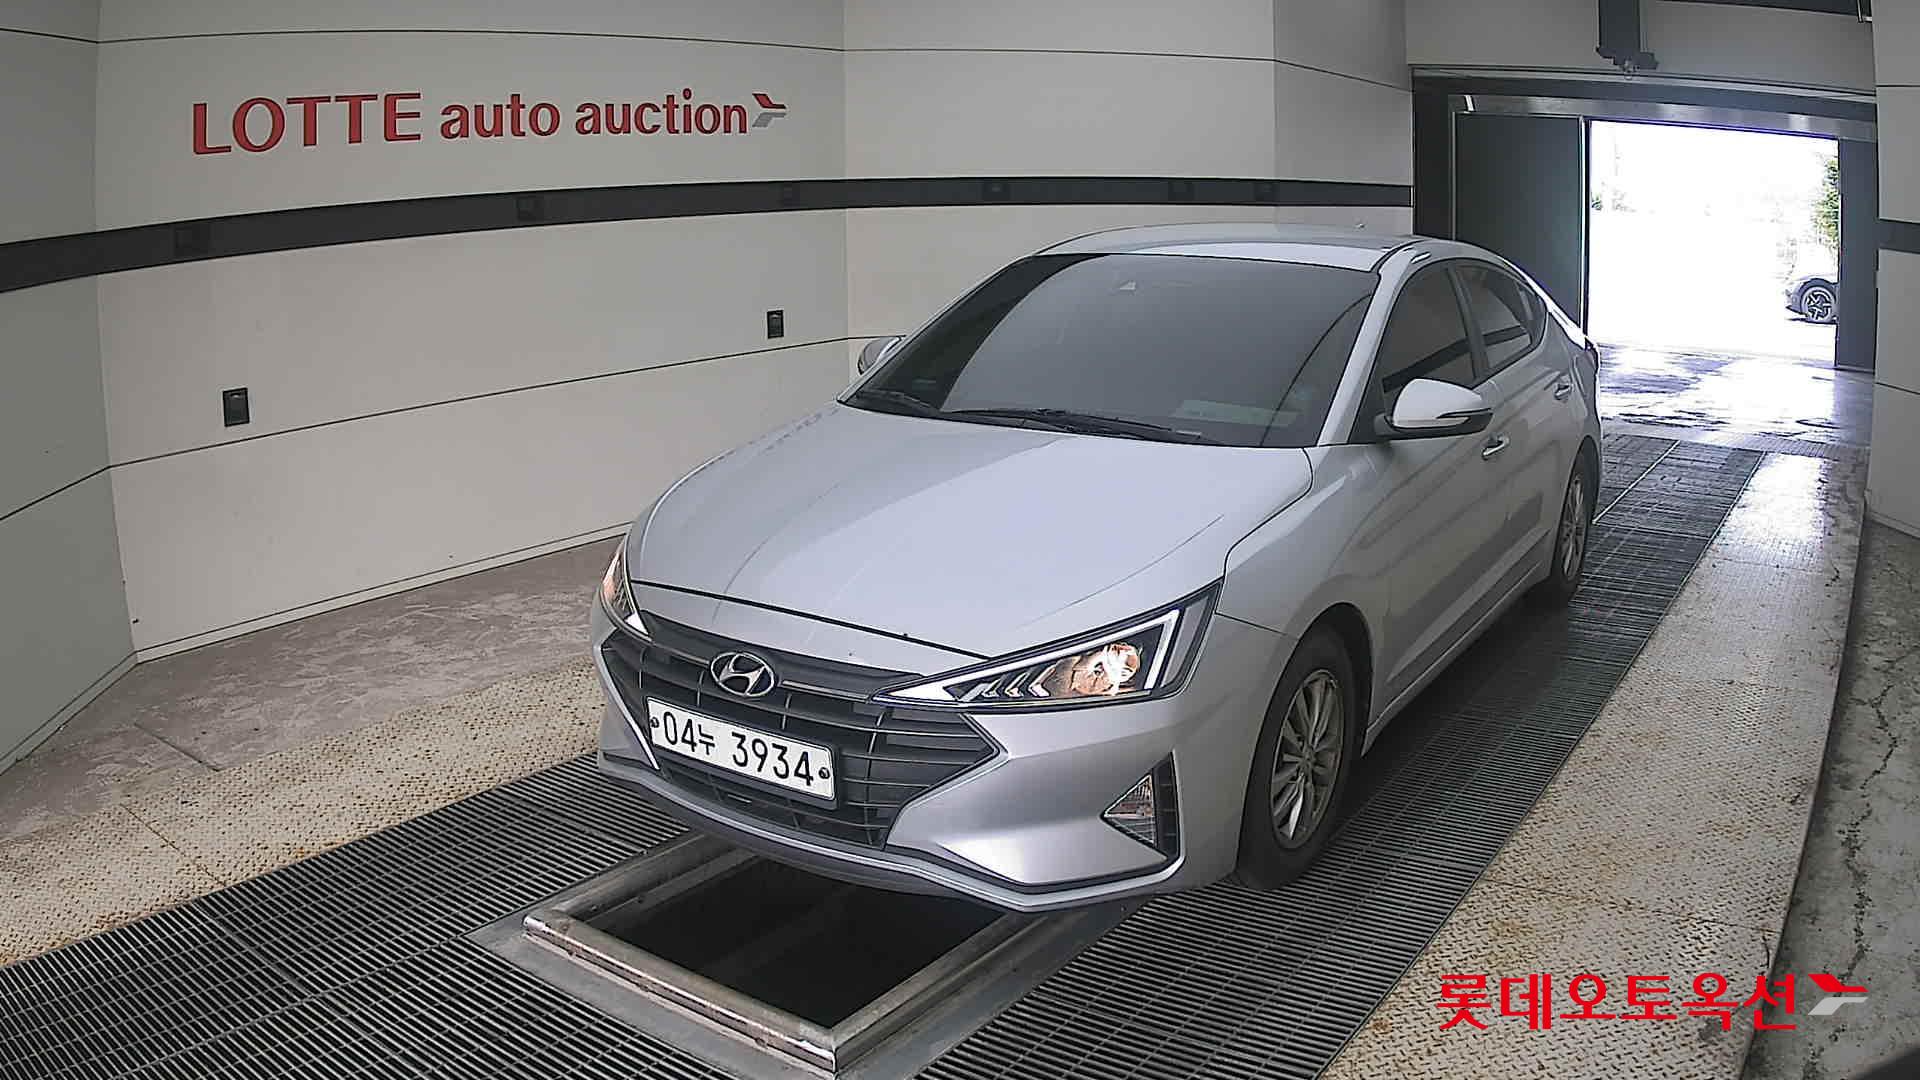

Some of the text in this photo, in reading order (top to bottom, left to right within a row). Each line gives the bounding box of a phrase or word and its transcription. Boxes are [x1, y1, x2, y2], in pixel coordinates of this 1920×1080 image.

[192, 88, 748, 155] LOTTE auto auction
[663, 711, 814, 786] 04누 3934
